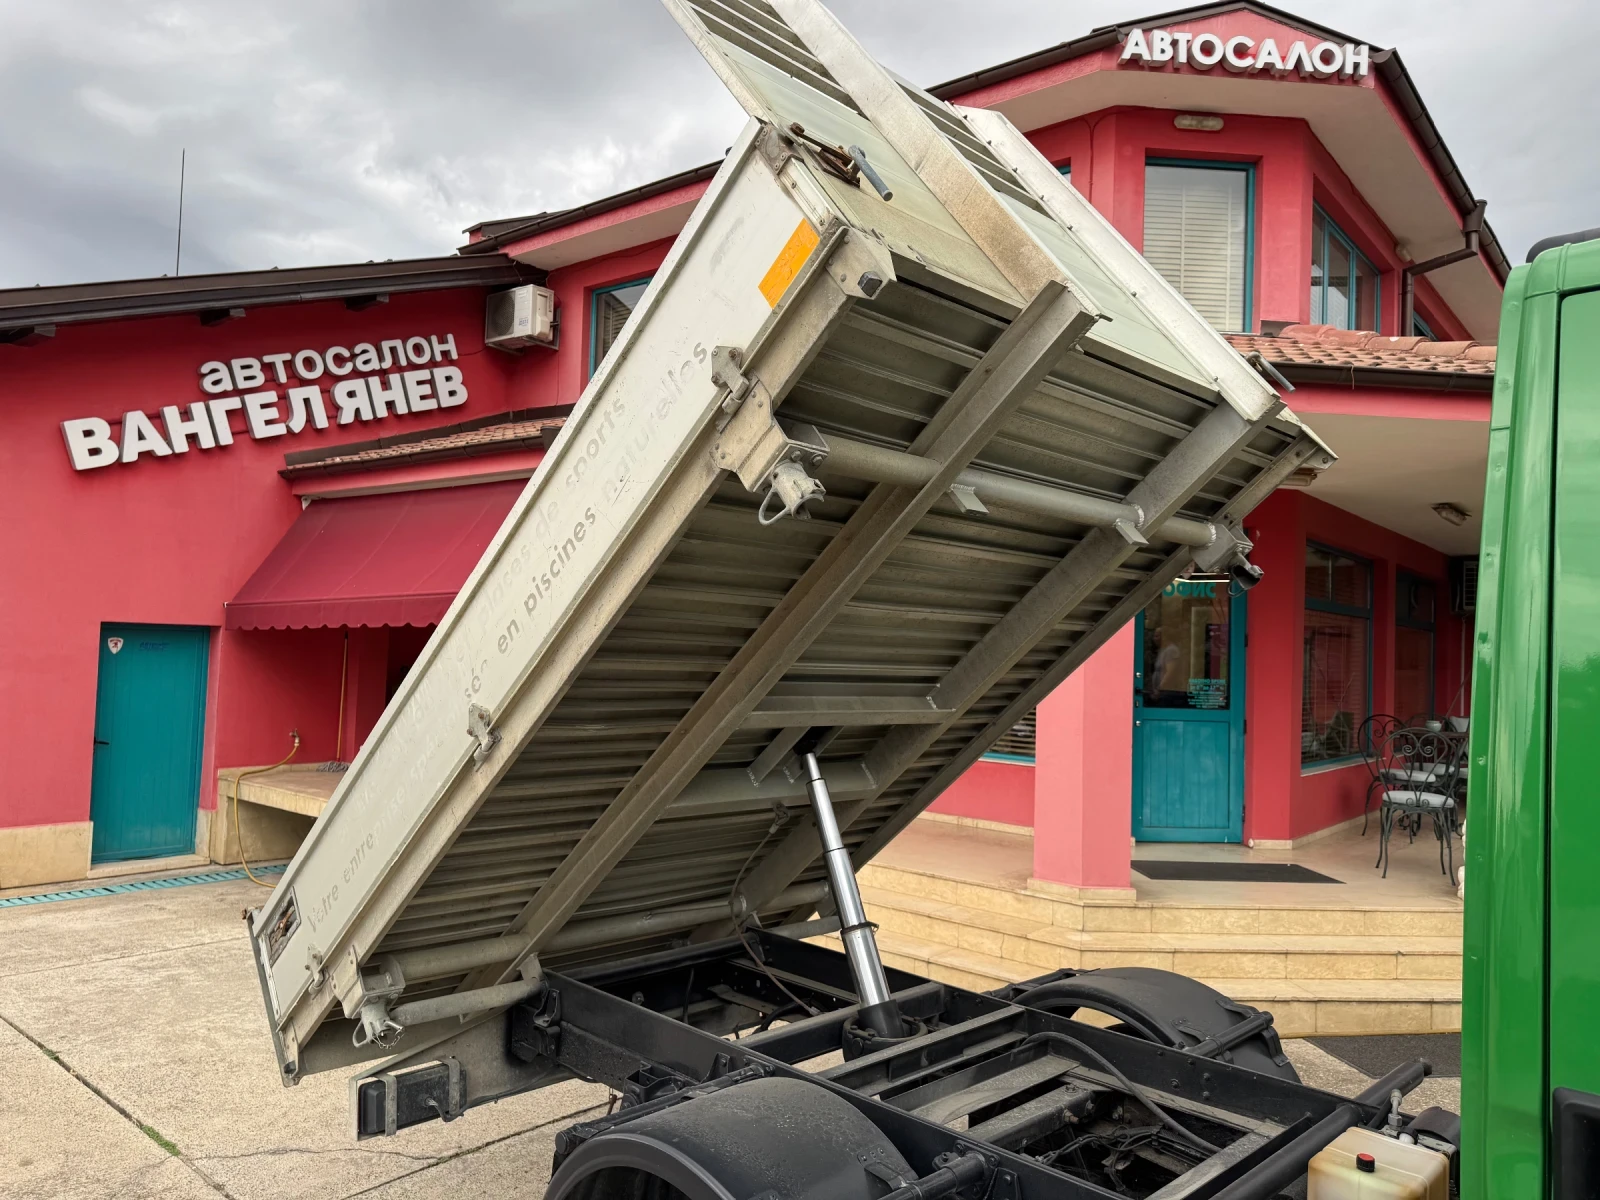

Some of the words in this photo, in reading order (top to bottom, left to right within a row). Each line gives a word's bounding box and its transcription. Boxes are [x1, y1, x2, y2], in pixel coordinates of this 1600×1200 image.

[1118, 28, 1369, 80] АВТОСАЛОН
[198, 334, 459, 394] автосалон
[60, 385, 329, 470] ВАНГЕЛ
[333, 366, 468, 424] ЯНЕВ
[565, 396, 628, 496] sports
[1162, 581, 1217, 599] ОФИС
[307, 883, 340, 933] Votre
[496, 616, 521, 655] en
[522, 505, 597, 618] piscines
[602, 339, 708, 505] naturelles
